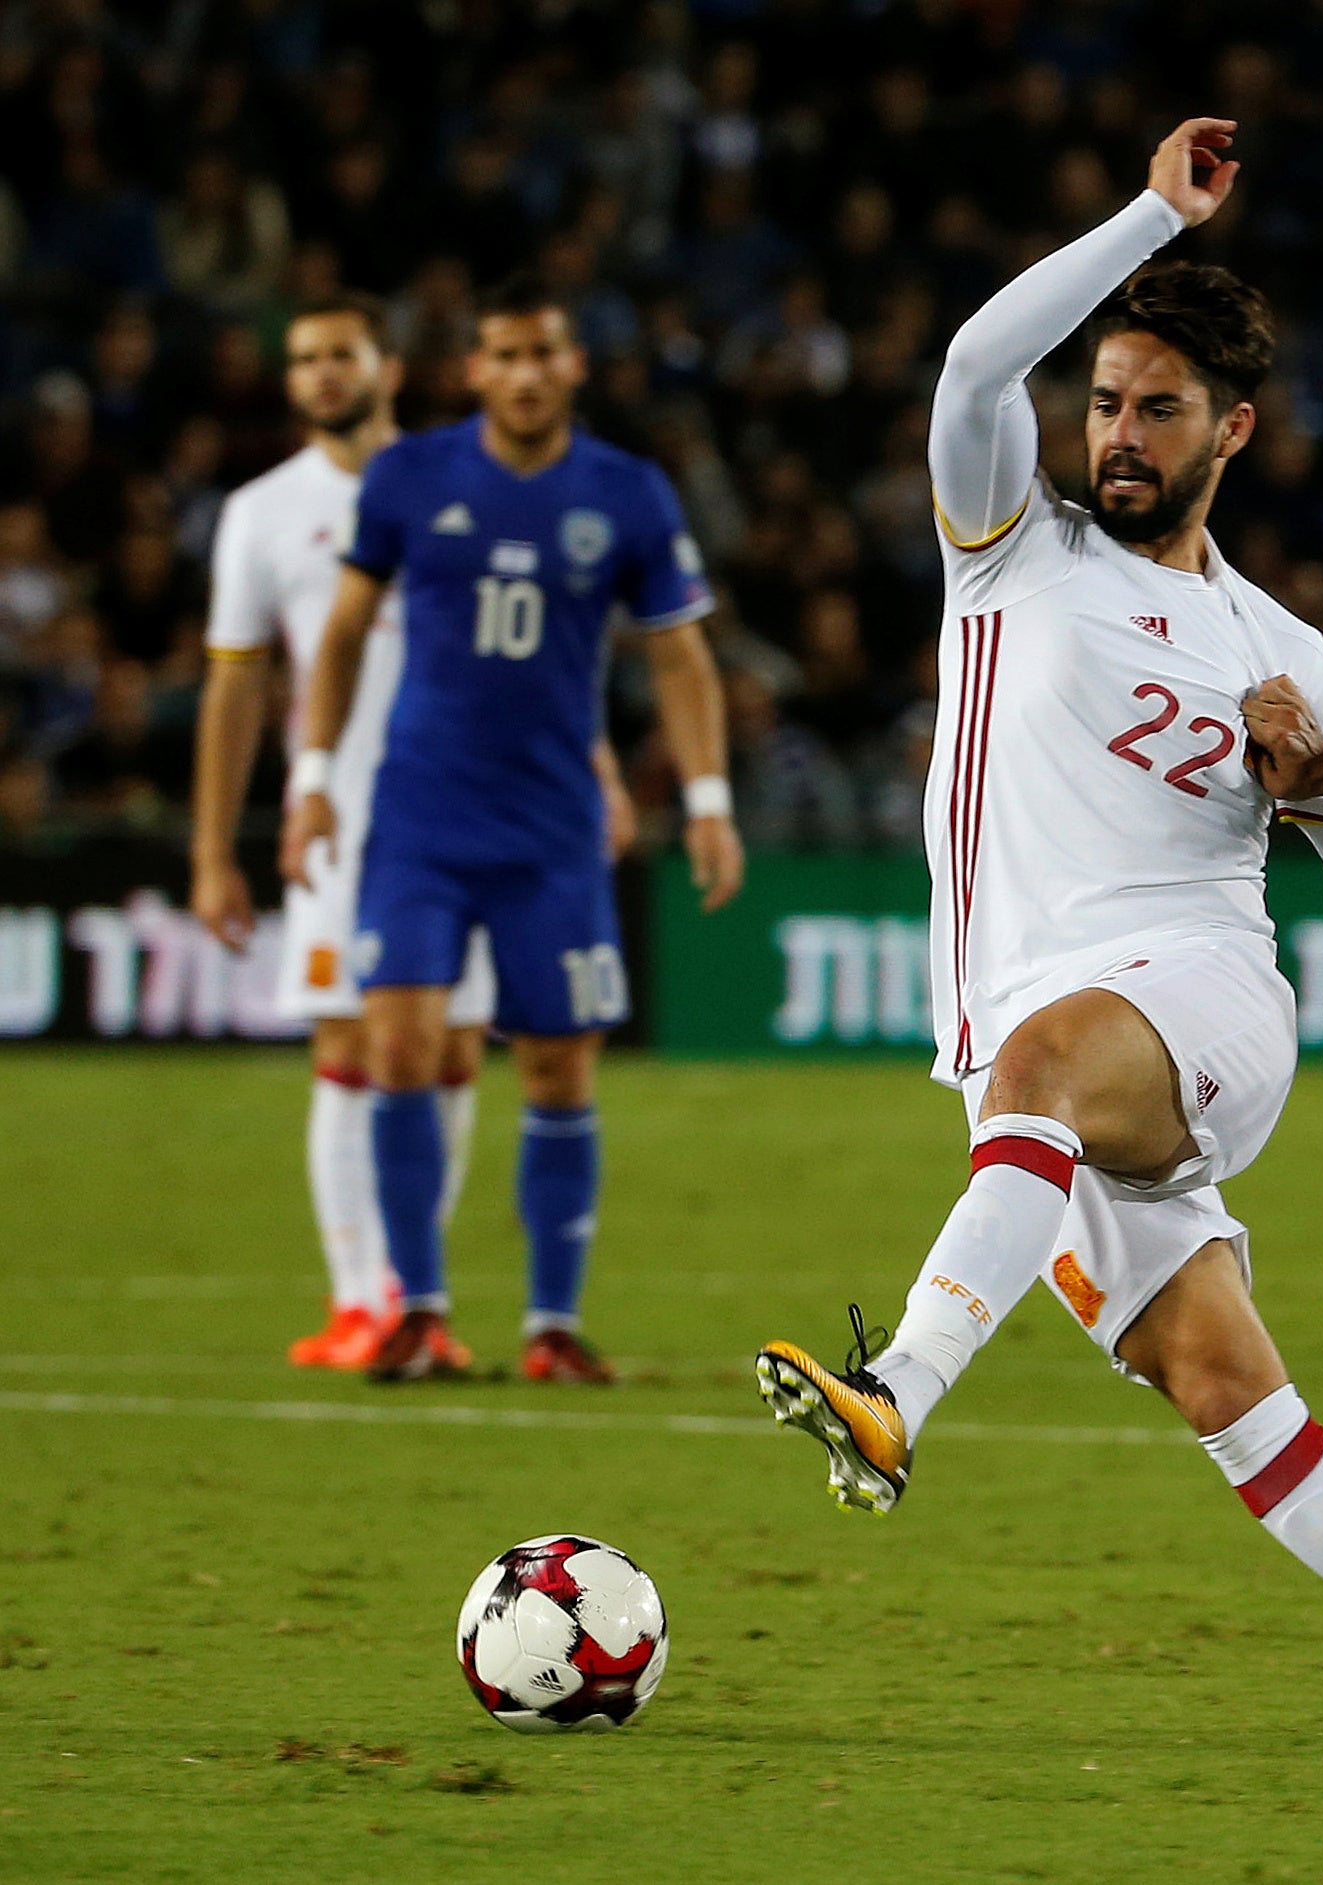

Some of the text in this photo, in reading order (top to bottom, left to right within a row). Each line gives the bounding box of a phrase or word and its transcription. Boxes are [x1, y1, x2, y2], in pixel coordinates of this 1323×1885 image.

[473, 574, 544, 660] 10
[1107, 682, 1236, 798] 22
[561, 943, 629, 1025] 10
